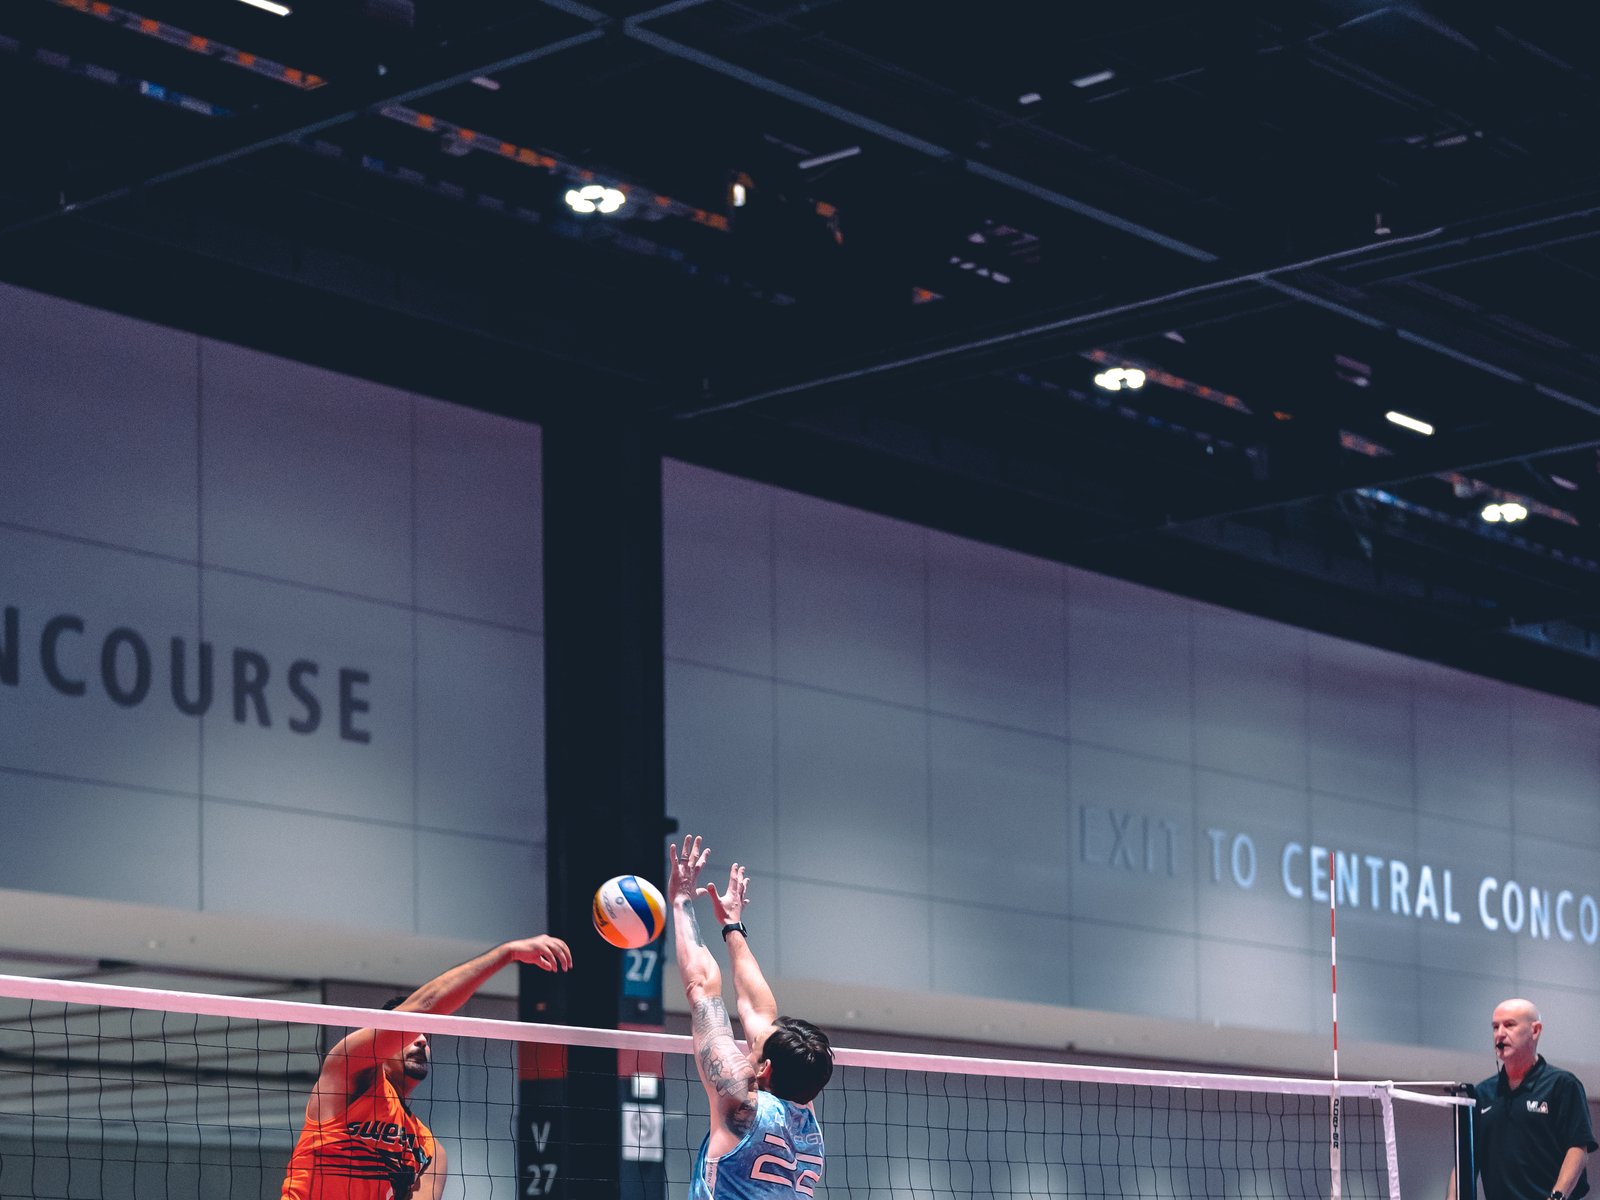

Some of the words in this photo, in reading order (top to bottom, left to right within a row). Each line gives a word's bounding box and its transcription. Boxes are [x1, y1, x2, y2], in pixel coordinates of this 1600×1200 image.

[1206, 827, 1257, 889] TO
[1282, 842, 1461, 924] CENTRAL
[1478, 876, 1599, 945] CONCO
[625, 949, 658, 982] 27
[531, 1121, 551, 1152] V
[526, 1163, 558, 1196] 27
